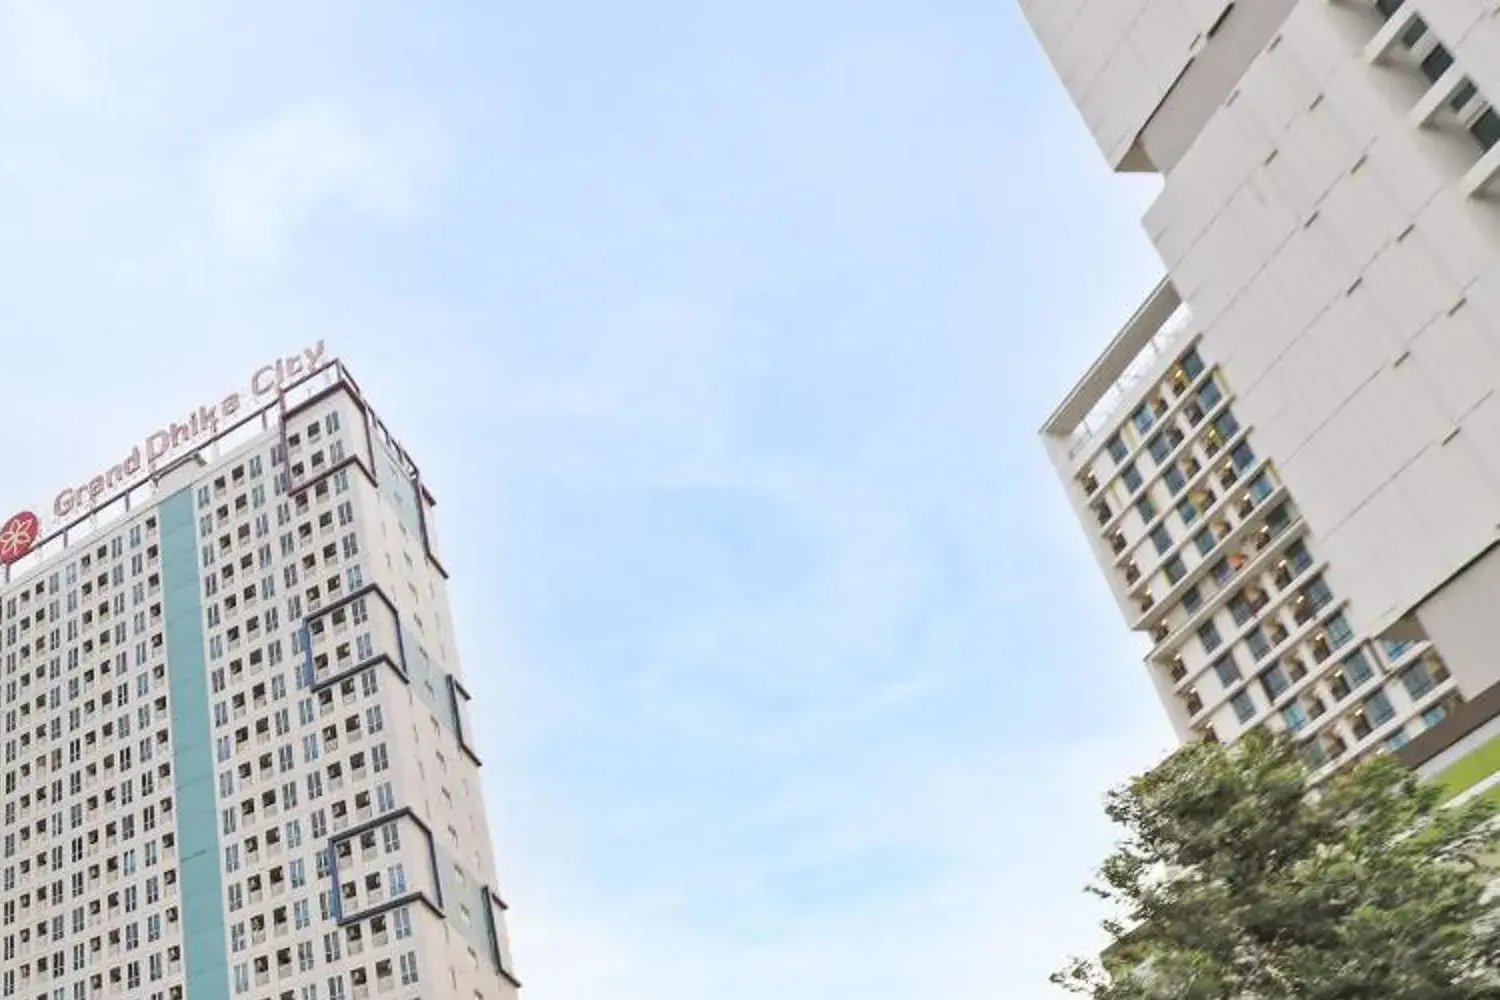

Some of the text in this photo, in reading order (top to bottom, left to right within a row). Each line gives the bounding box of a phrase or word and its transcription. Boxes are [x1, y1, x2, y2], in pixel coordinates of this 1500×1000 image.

[53, 339, 325, 517] Grand Dhika City
